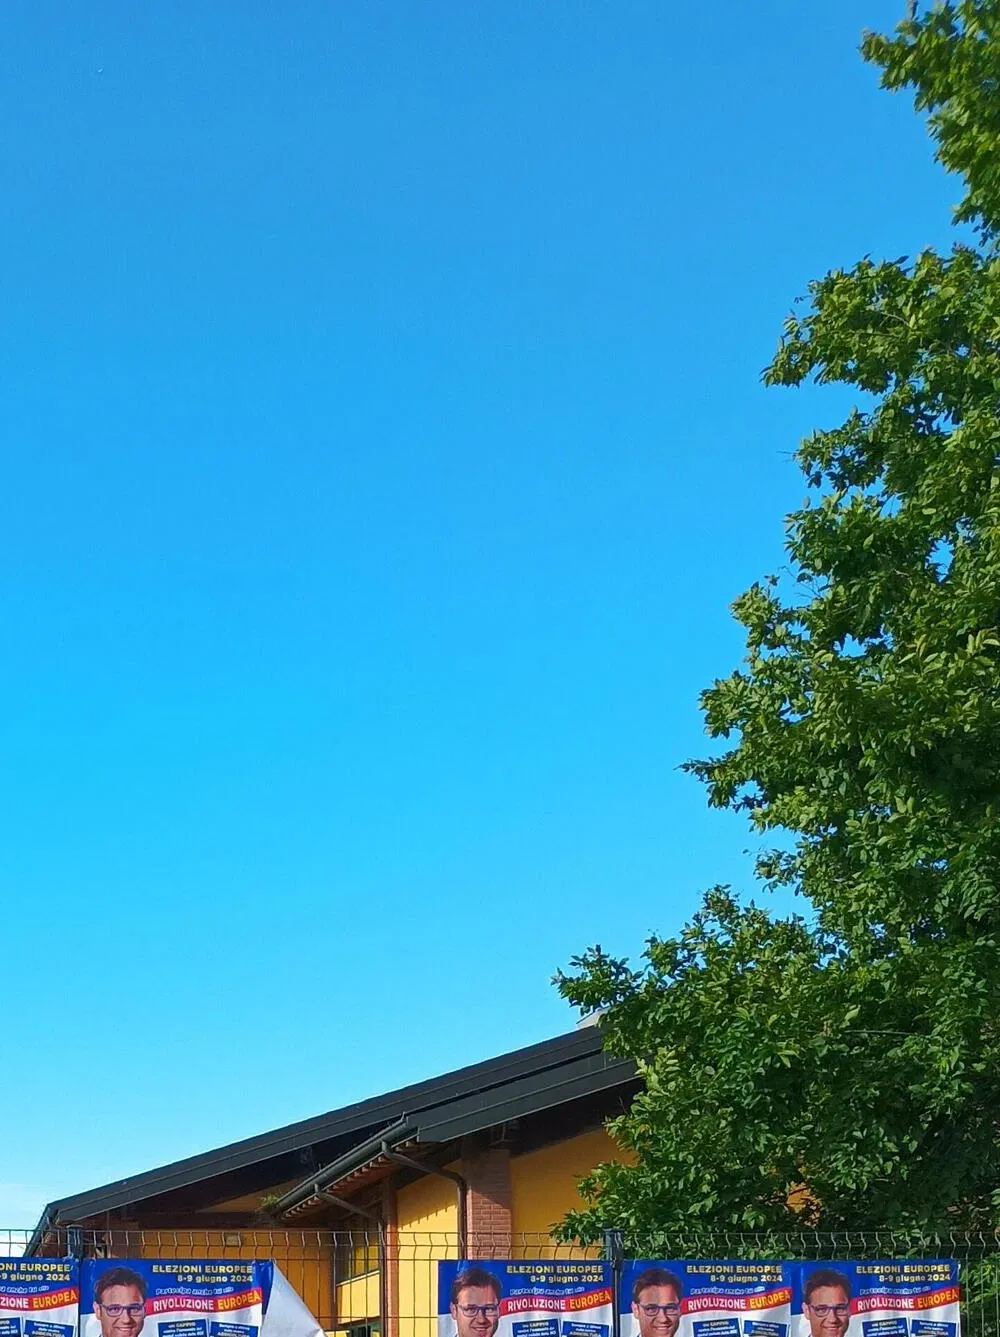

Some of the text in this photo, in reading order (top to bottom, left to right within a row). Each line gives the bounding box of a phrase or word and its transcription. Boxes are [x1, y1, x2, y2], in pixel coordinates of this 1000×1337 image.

[20, 1263, 70, 1272] EUROPEE
[152, 1265, 253, 1274] ELEZIONI EUROPEE
[506, 1265, 603, 1274] ELEZIONI EUROPEE
[687, 1265, 782, 1274] ELEZIONI EUROPEE
[856, 1264, 949, 1274] ELEZIONI EUROPEE
[11, 1273, 43, 1282] giugno
[196, 1274, 227, 1284] giugno
[548, 1275, 578, 1284] giugno
[581, 1274, 604, 1282] 2024
[728, 1274, 758, 1284] giugno
[896, 1274, 925, 1284] giugno
[928, 1273, 950, 1281] 2024
[33, 1289, 76, 1308] EUROPEA
[154, 1290, 260, 1311] RIVOLUZIONE EUROPEA
[508, 1298, 566, 1311] RIVOLUZIONE
[569, 1290, 610, 1309] EUROPEA
[688, 1297, 746, 1310] RIVOLUZIONE
[750, 1289, 790, 1308] EUROPEA
[857, 1297, 913, 1310] RIVOLUZIONE
[917, 1288, 956, 1307] EUROPEA
